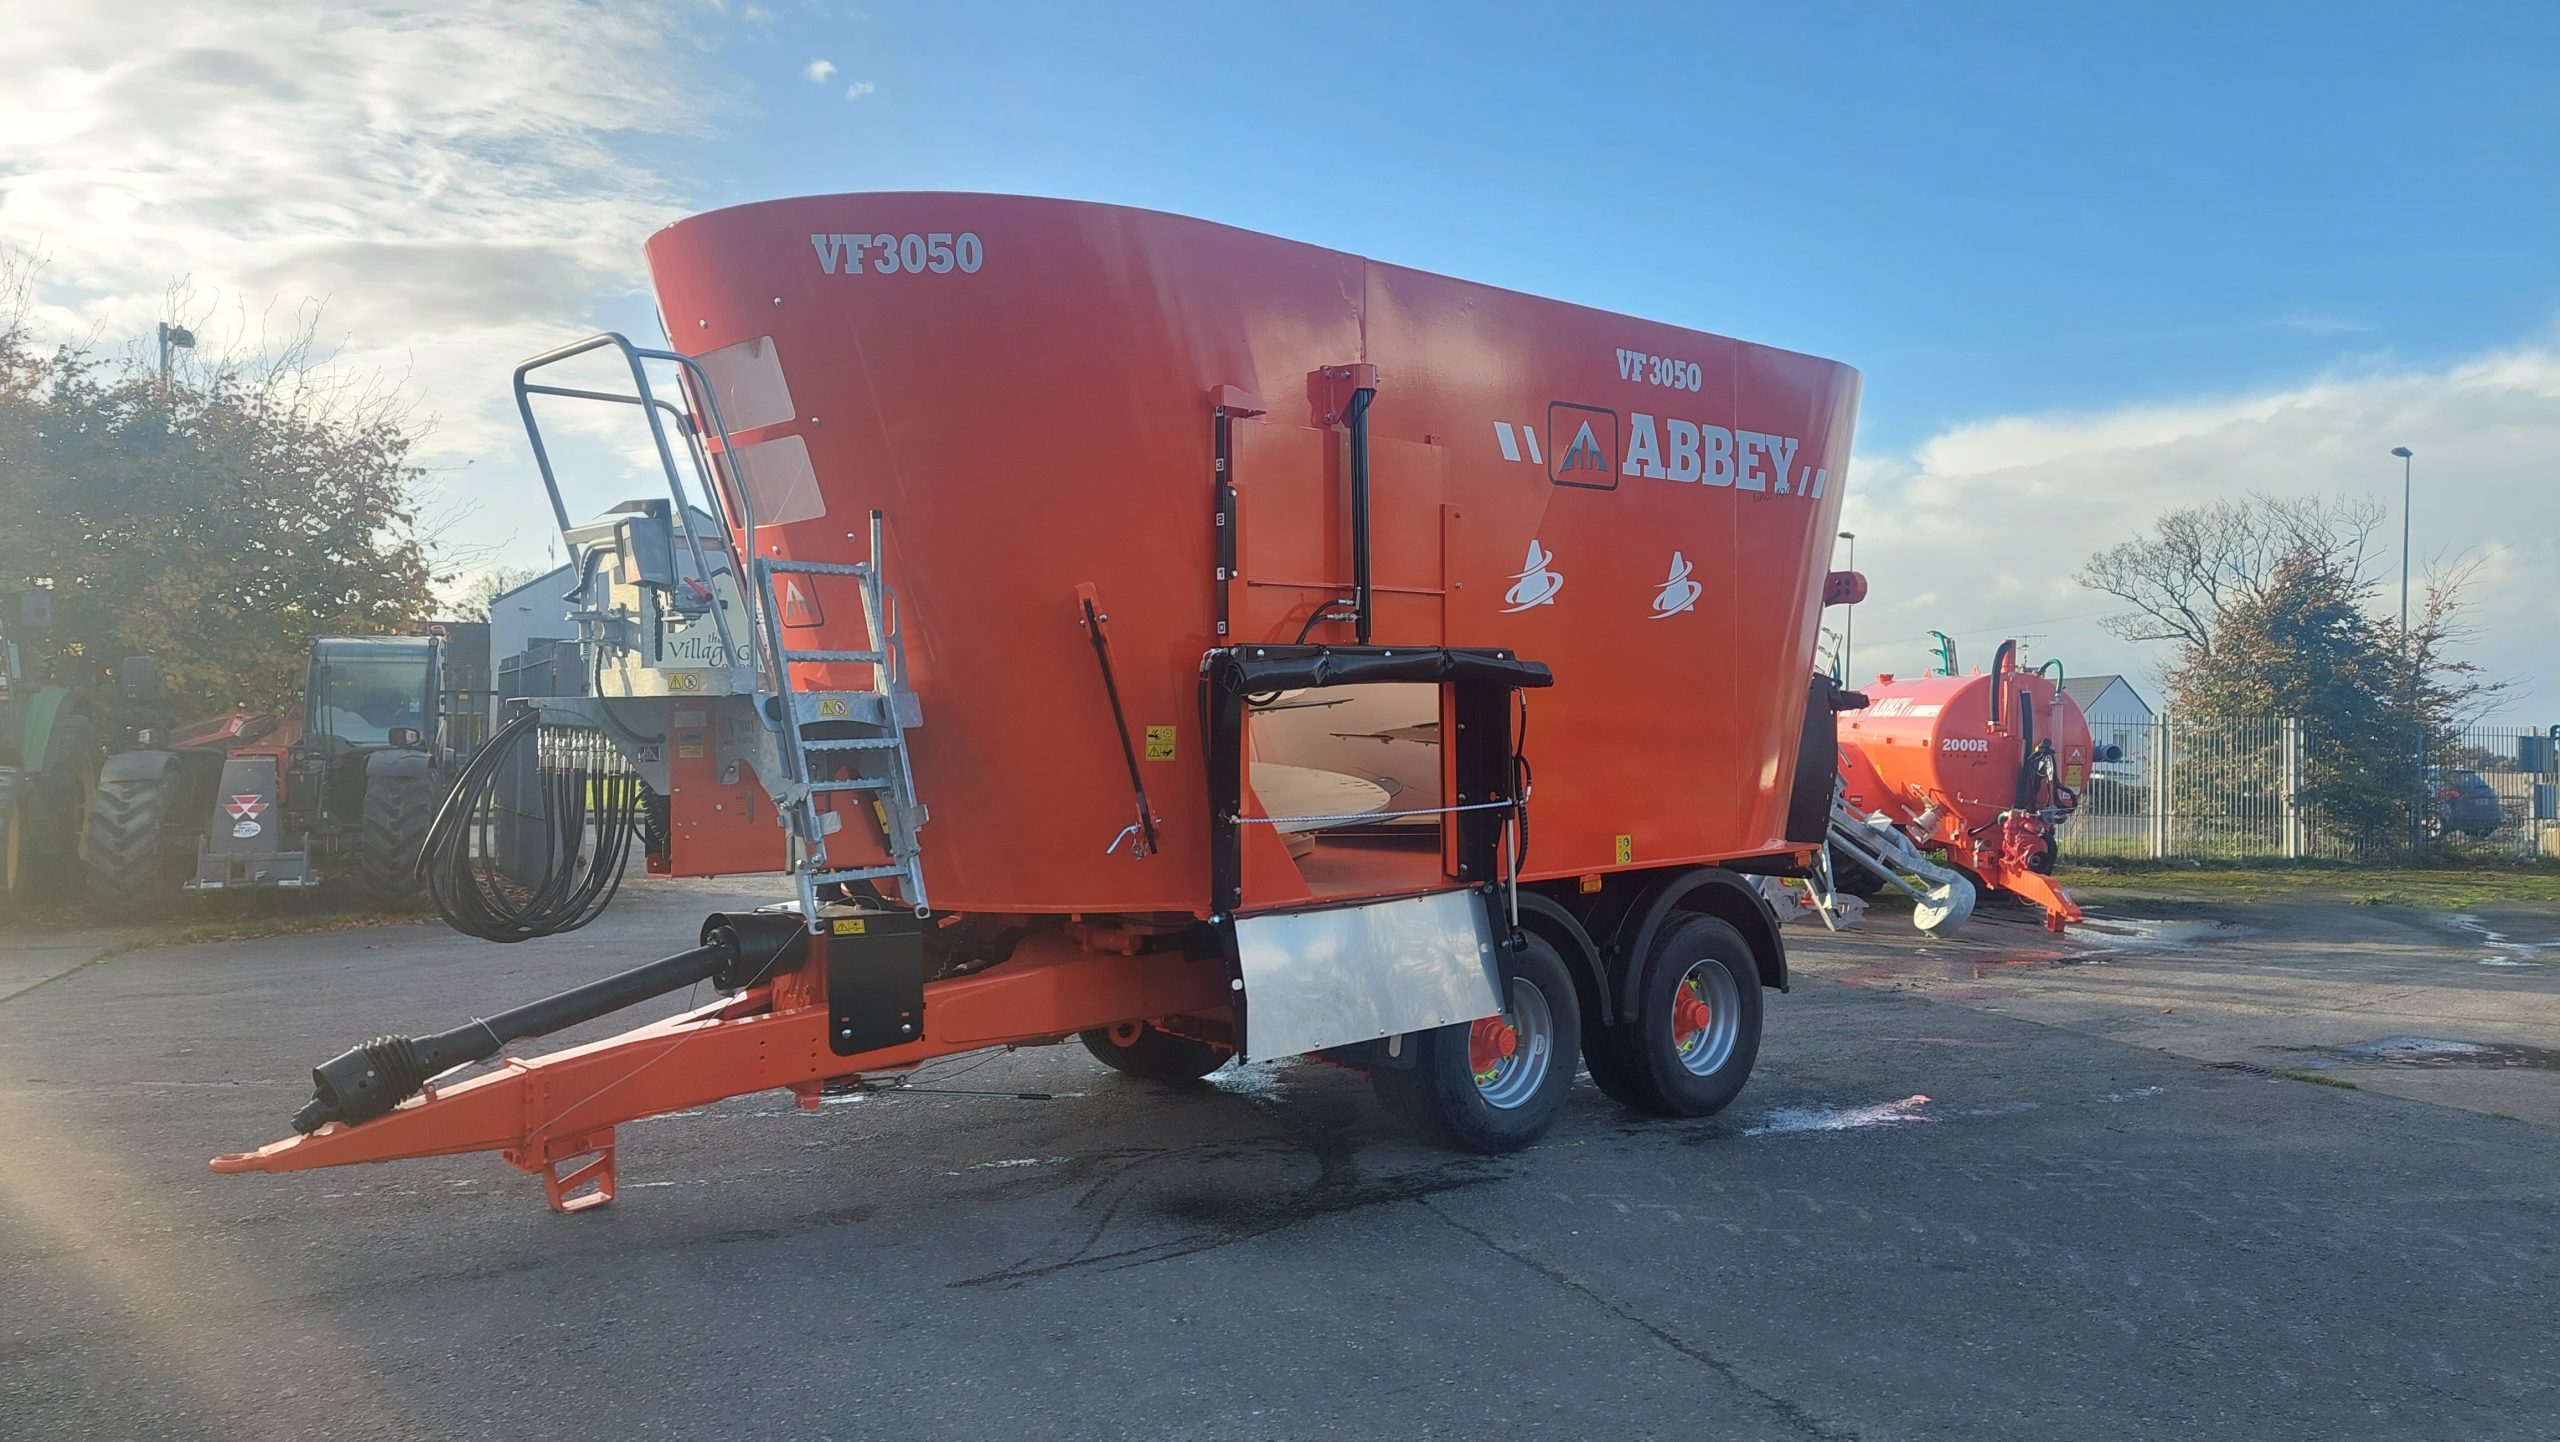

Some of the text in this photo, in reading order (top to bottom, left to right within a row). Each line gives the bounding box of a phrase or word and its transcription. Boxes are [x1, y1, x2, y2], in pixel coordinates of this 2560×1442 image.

[810, 231, 984, 275] VF3050
[1616, 347, 1702, 393] VF 3050
[1622, 412, 1799, 493] ABBEY
[1216, 460, 1223, 470] 3
[1217, 514, 1224, 525] 2
[1218, 622, 1225, 633] 0
[667, 637, 724, 667] Villag
[1942, 738, 1989, 752] 2000R
